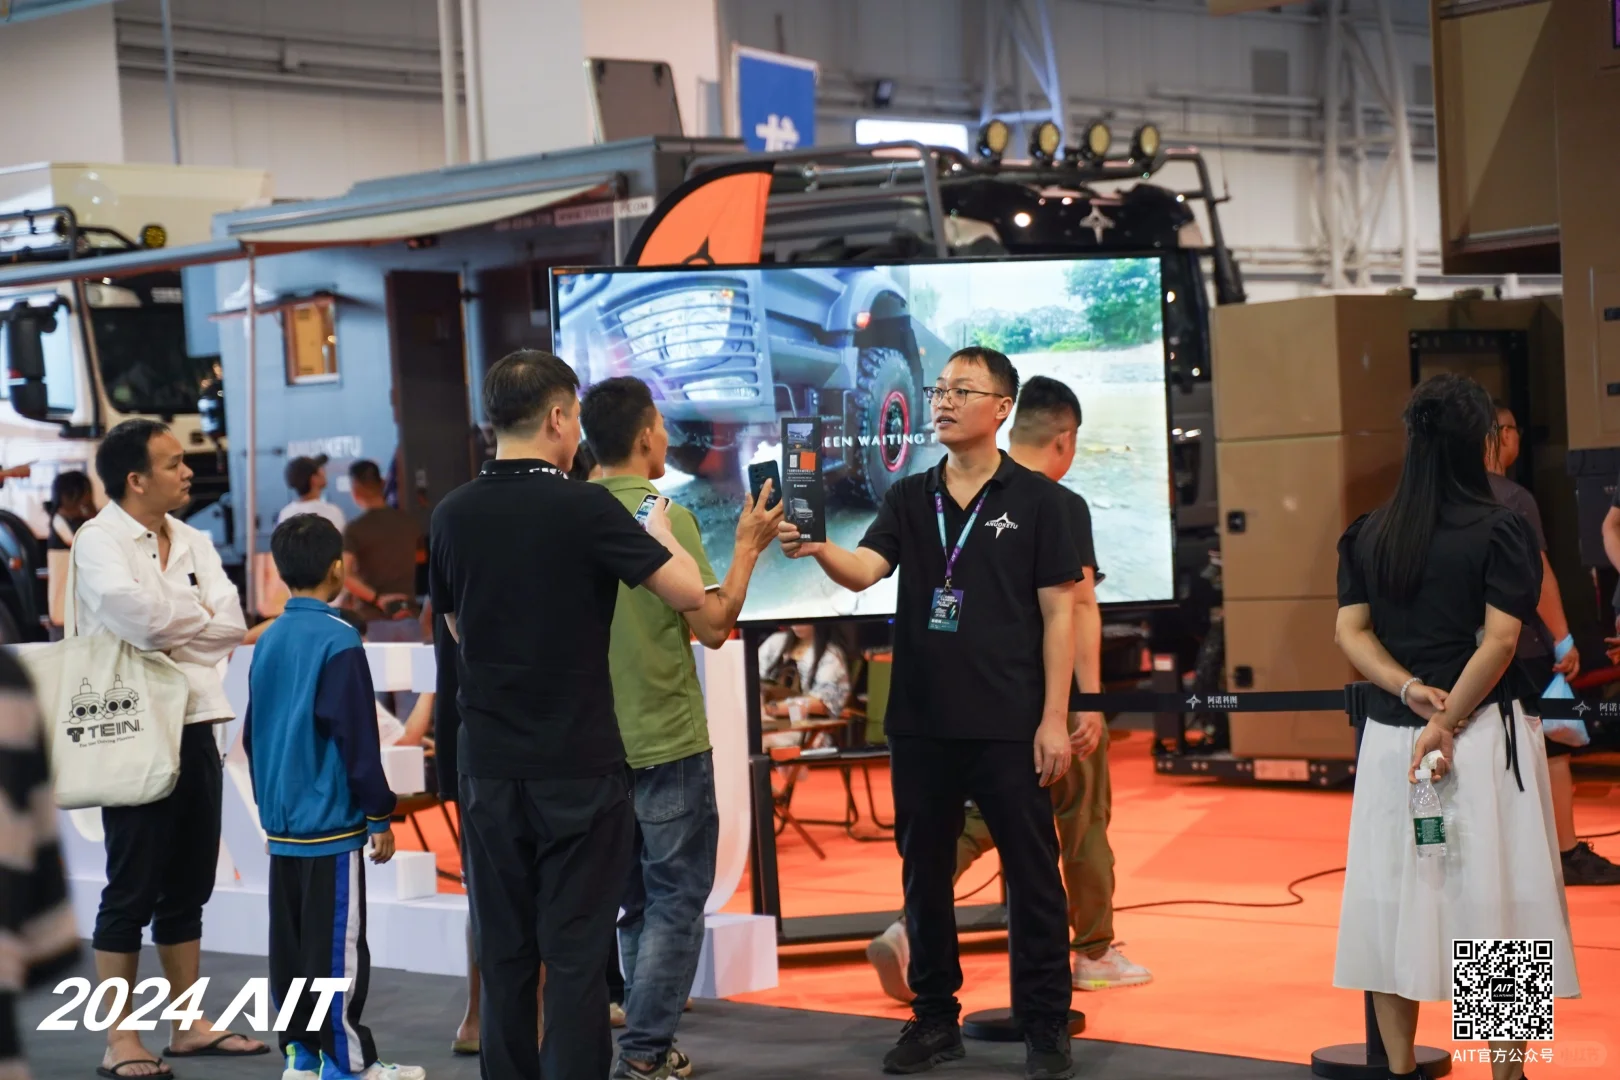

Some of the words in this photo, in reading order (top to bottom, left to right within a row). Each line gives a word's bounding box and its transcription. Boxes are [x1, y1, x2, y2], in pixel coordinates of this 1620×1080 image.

[821, 436, 853, 448] EEN
[858, 433, 925, 447] WAITING
[1599, 702, 1620, 712] 阿诺
[87, 719, 140, 739] TEIN
